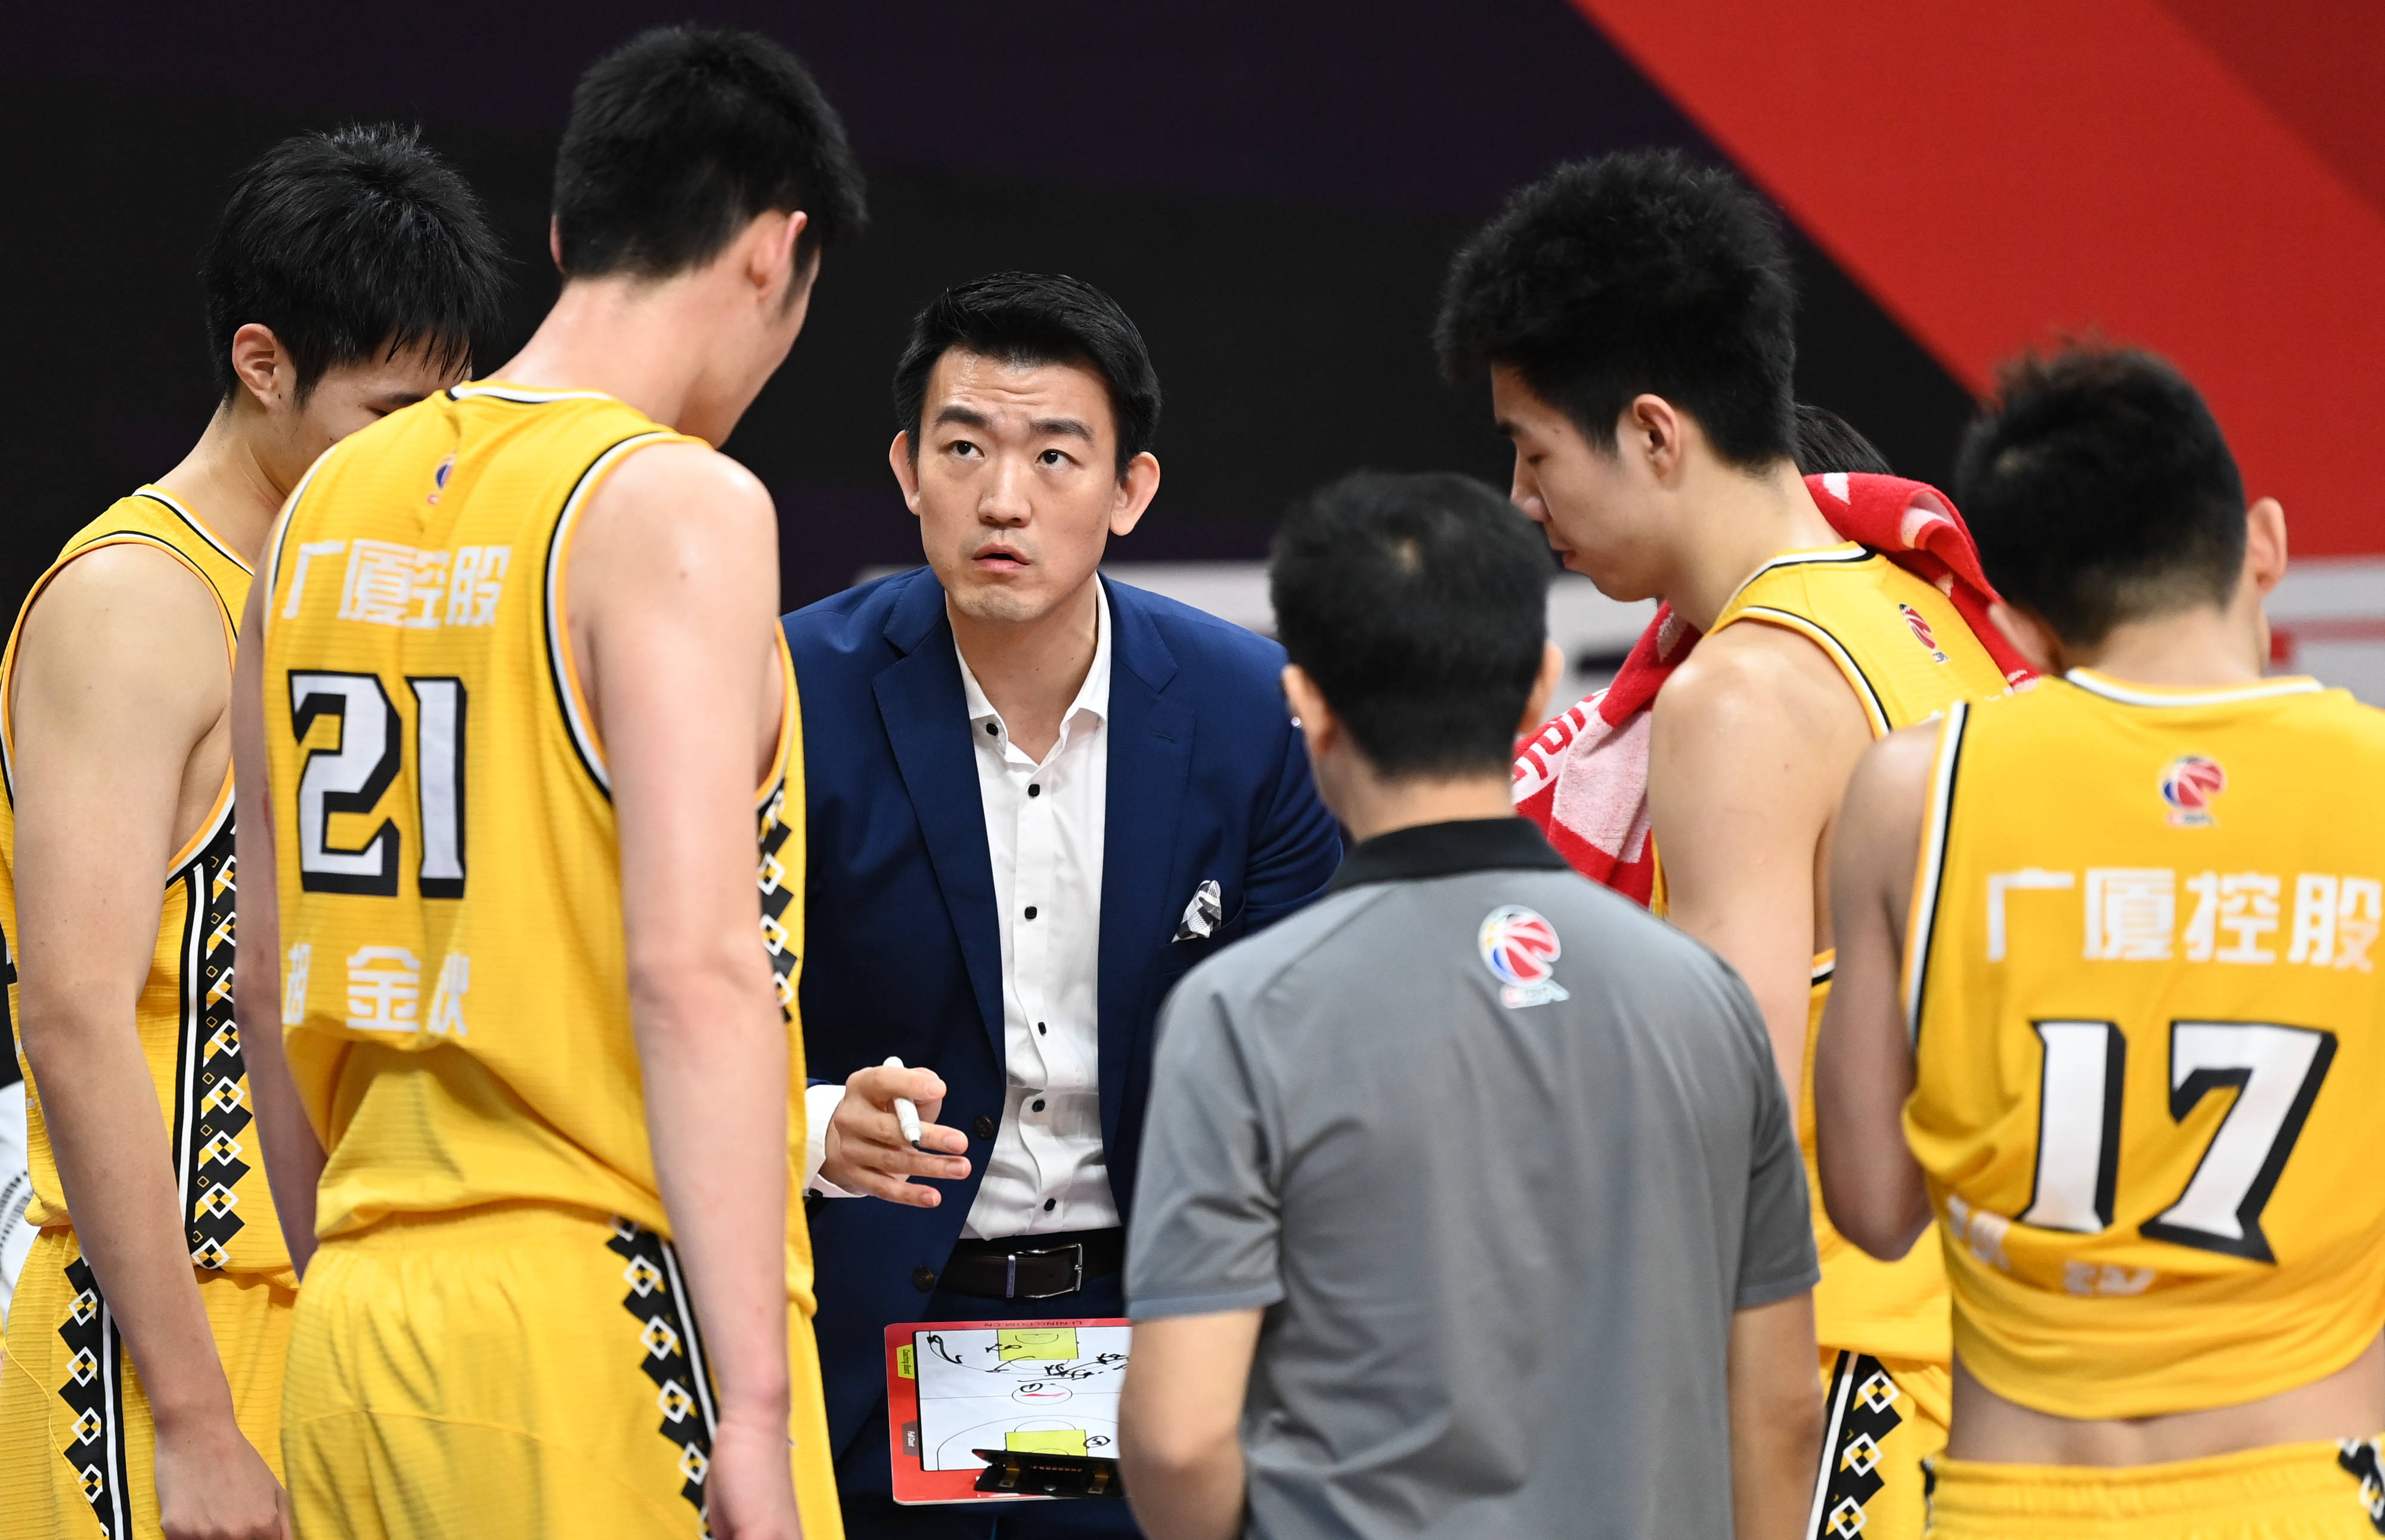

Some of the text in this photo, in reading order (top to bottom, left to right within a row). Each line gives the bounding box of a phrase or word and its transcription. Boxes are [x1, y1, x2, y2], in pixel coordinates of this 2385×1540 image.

[287, 668, 467, 899] 21
[1986, 867, 2383, 974] 广厦控股
[2014, 1018, 2339, 1266] 17
